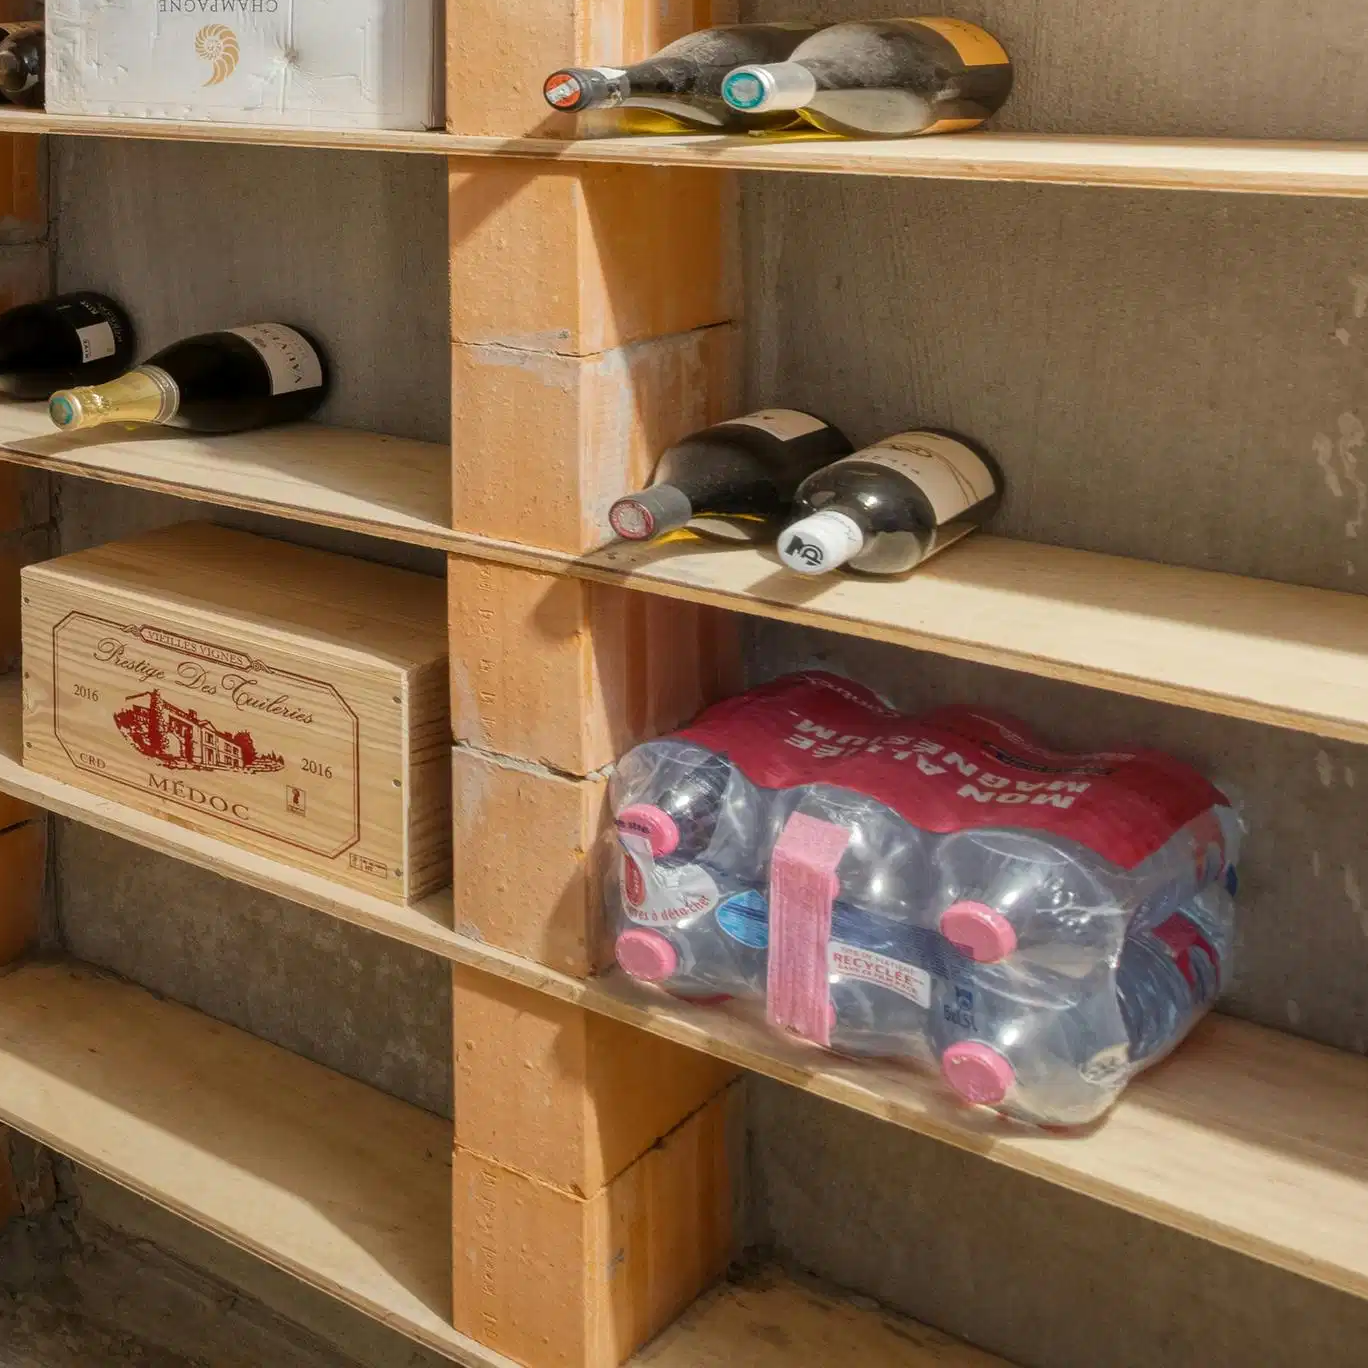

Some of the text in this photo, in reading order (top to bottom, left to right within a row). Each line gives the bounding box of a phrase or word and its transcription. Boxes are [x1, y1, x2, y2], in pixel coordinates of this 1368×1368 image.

[159, 0, 278, 13] CHAMPAGNE
[147, 630, 244, 665] VIEILLES VIGNES
[73, 684, 99, 702] 2016
[93, 637, 314, 725] Prestige Des Tuileries
[79, 752, 106, 770] CRD
[300, 757, 333, 780] 2016
[147, 773, 250, 821] MÉDOC
[956, 783, 1076, 809] MON
